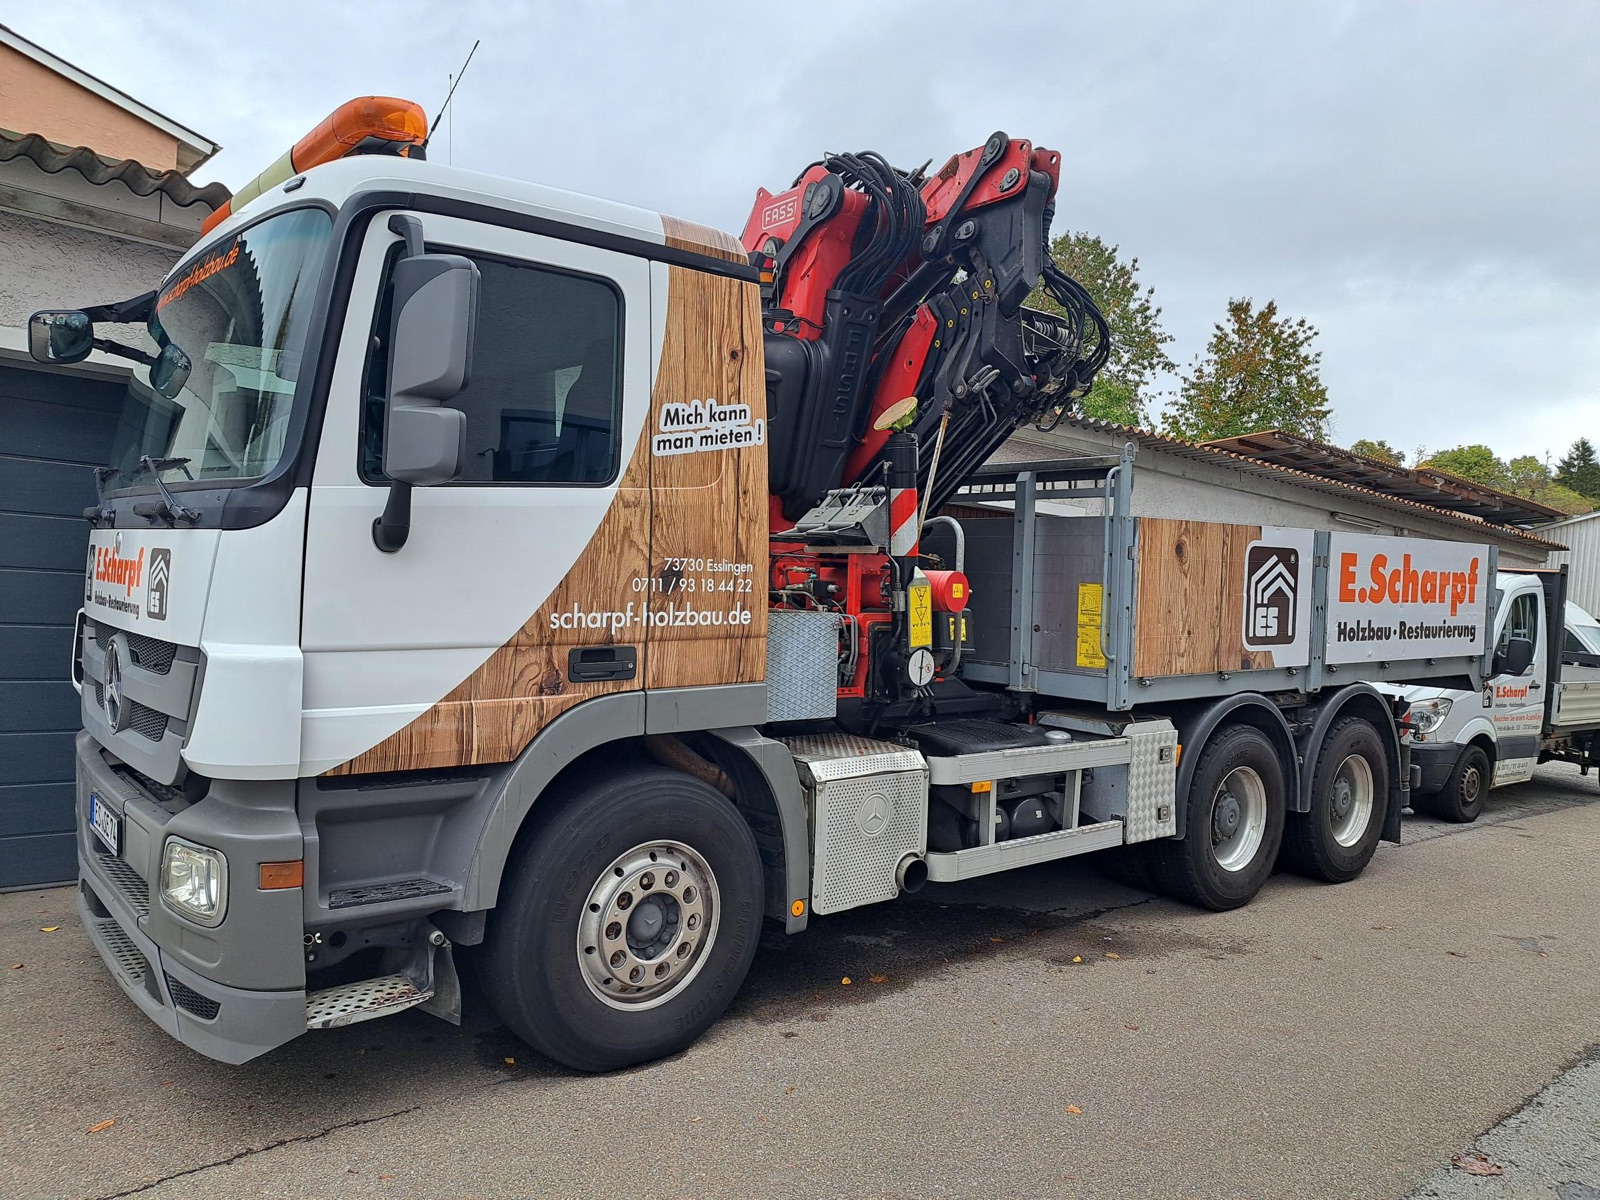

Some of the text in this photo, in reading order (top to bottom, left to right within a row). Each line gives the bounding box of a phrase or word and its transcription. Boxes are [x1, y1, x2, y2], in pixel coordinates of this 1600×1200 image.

[765, 200, 797, 224] FASSI
[663, 403, 748, 427] Mich kann
[656, 434, 694, 452] man
[699, 428, 752, 447] mieten
[95, 546, 145, 597] E.Scharpf
[663, 557, 753, 576] 73730 Esslingen
[632, 577, 663, 592] 0711
[679, 577, 695, 592] 93
[700, 577, 715, 592] 18
[718, 577, 734, 592] 44
[737, 577, 752, 592] 22
[1338, 552, 1479, 616] E.Scharpf
[550, 602, 752, 635] scharpf-holzbau.de
[1337, 619, 1476, 643] Holzbau Restaurierung
[1495, 685, 1528, 700] E.Scharpf
